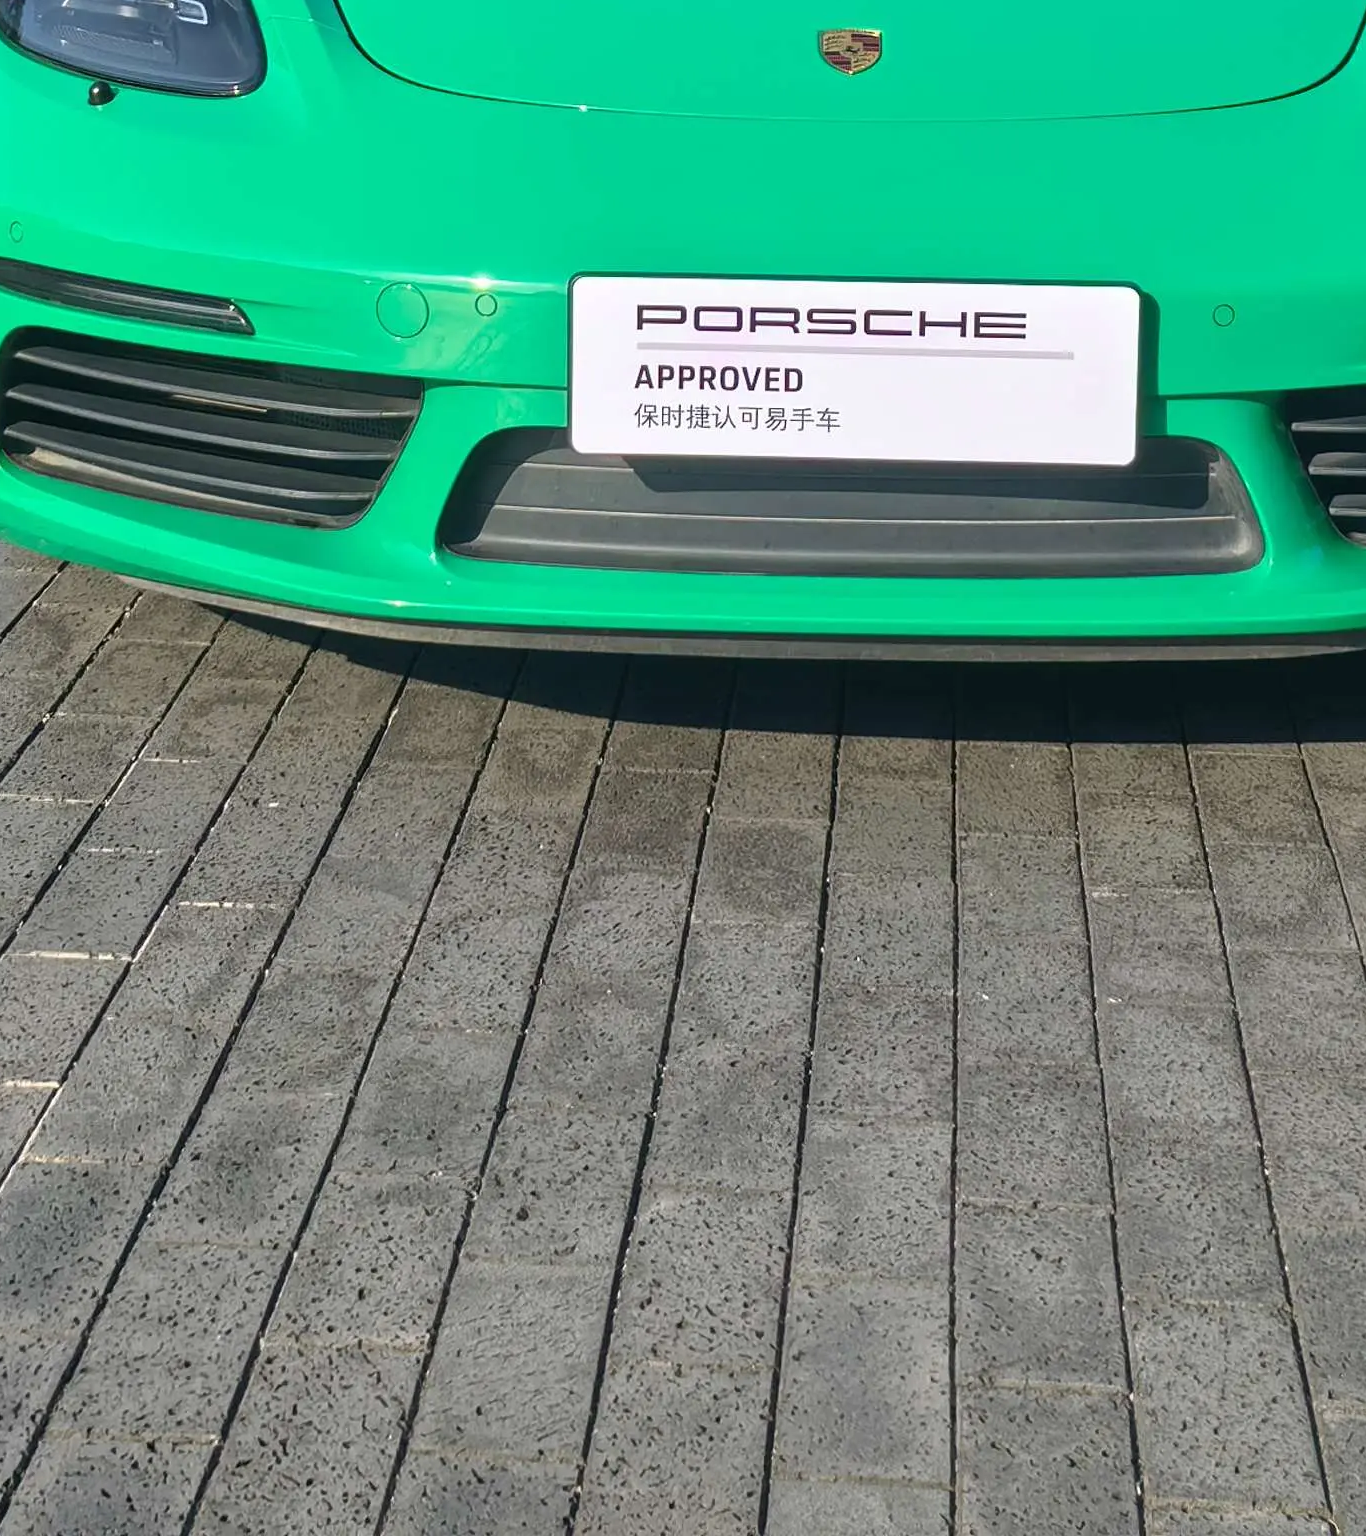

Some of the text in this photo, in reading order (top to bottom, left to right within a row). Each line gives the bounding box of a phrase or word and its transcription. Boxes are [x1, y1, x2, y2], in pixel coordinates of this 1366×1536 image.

[636, 304, 1027, 339] PORSCHE
[634, 364, 804, 393] APPROVED
[634, 402, 841, 433] 保时捷认可易手车
